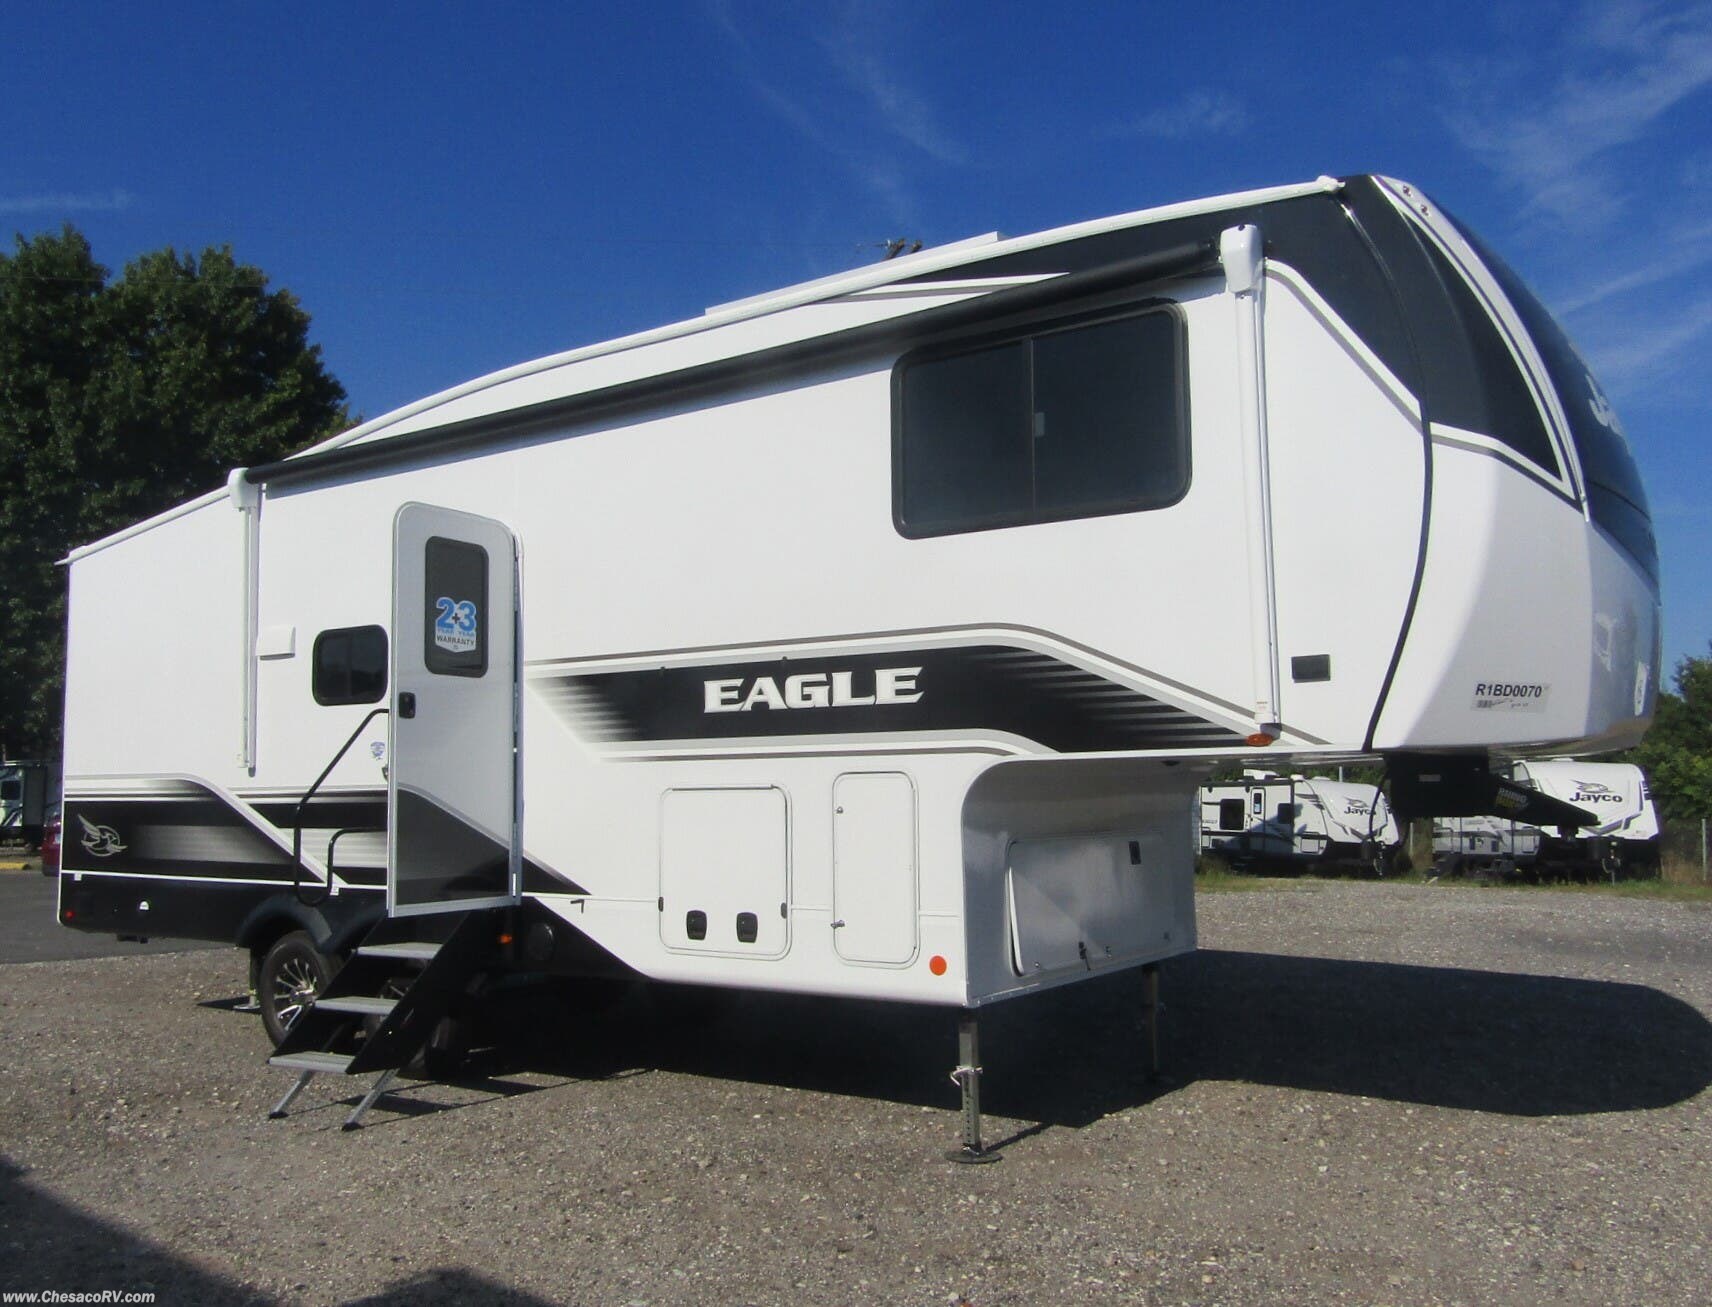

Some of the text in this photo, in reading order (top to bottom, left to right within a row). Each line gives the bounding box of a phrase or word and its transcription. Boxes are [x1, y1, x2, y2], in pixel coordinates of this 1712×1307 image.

[437, 634, 475, 646] WARRANTY
[704, 667, 924, 713] EAGLE
[1475, 683, 1542, 698] R1BD0070
[1569, 792, 1623, 803] Jayco
